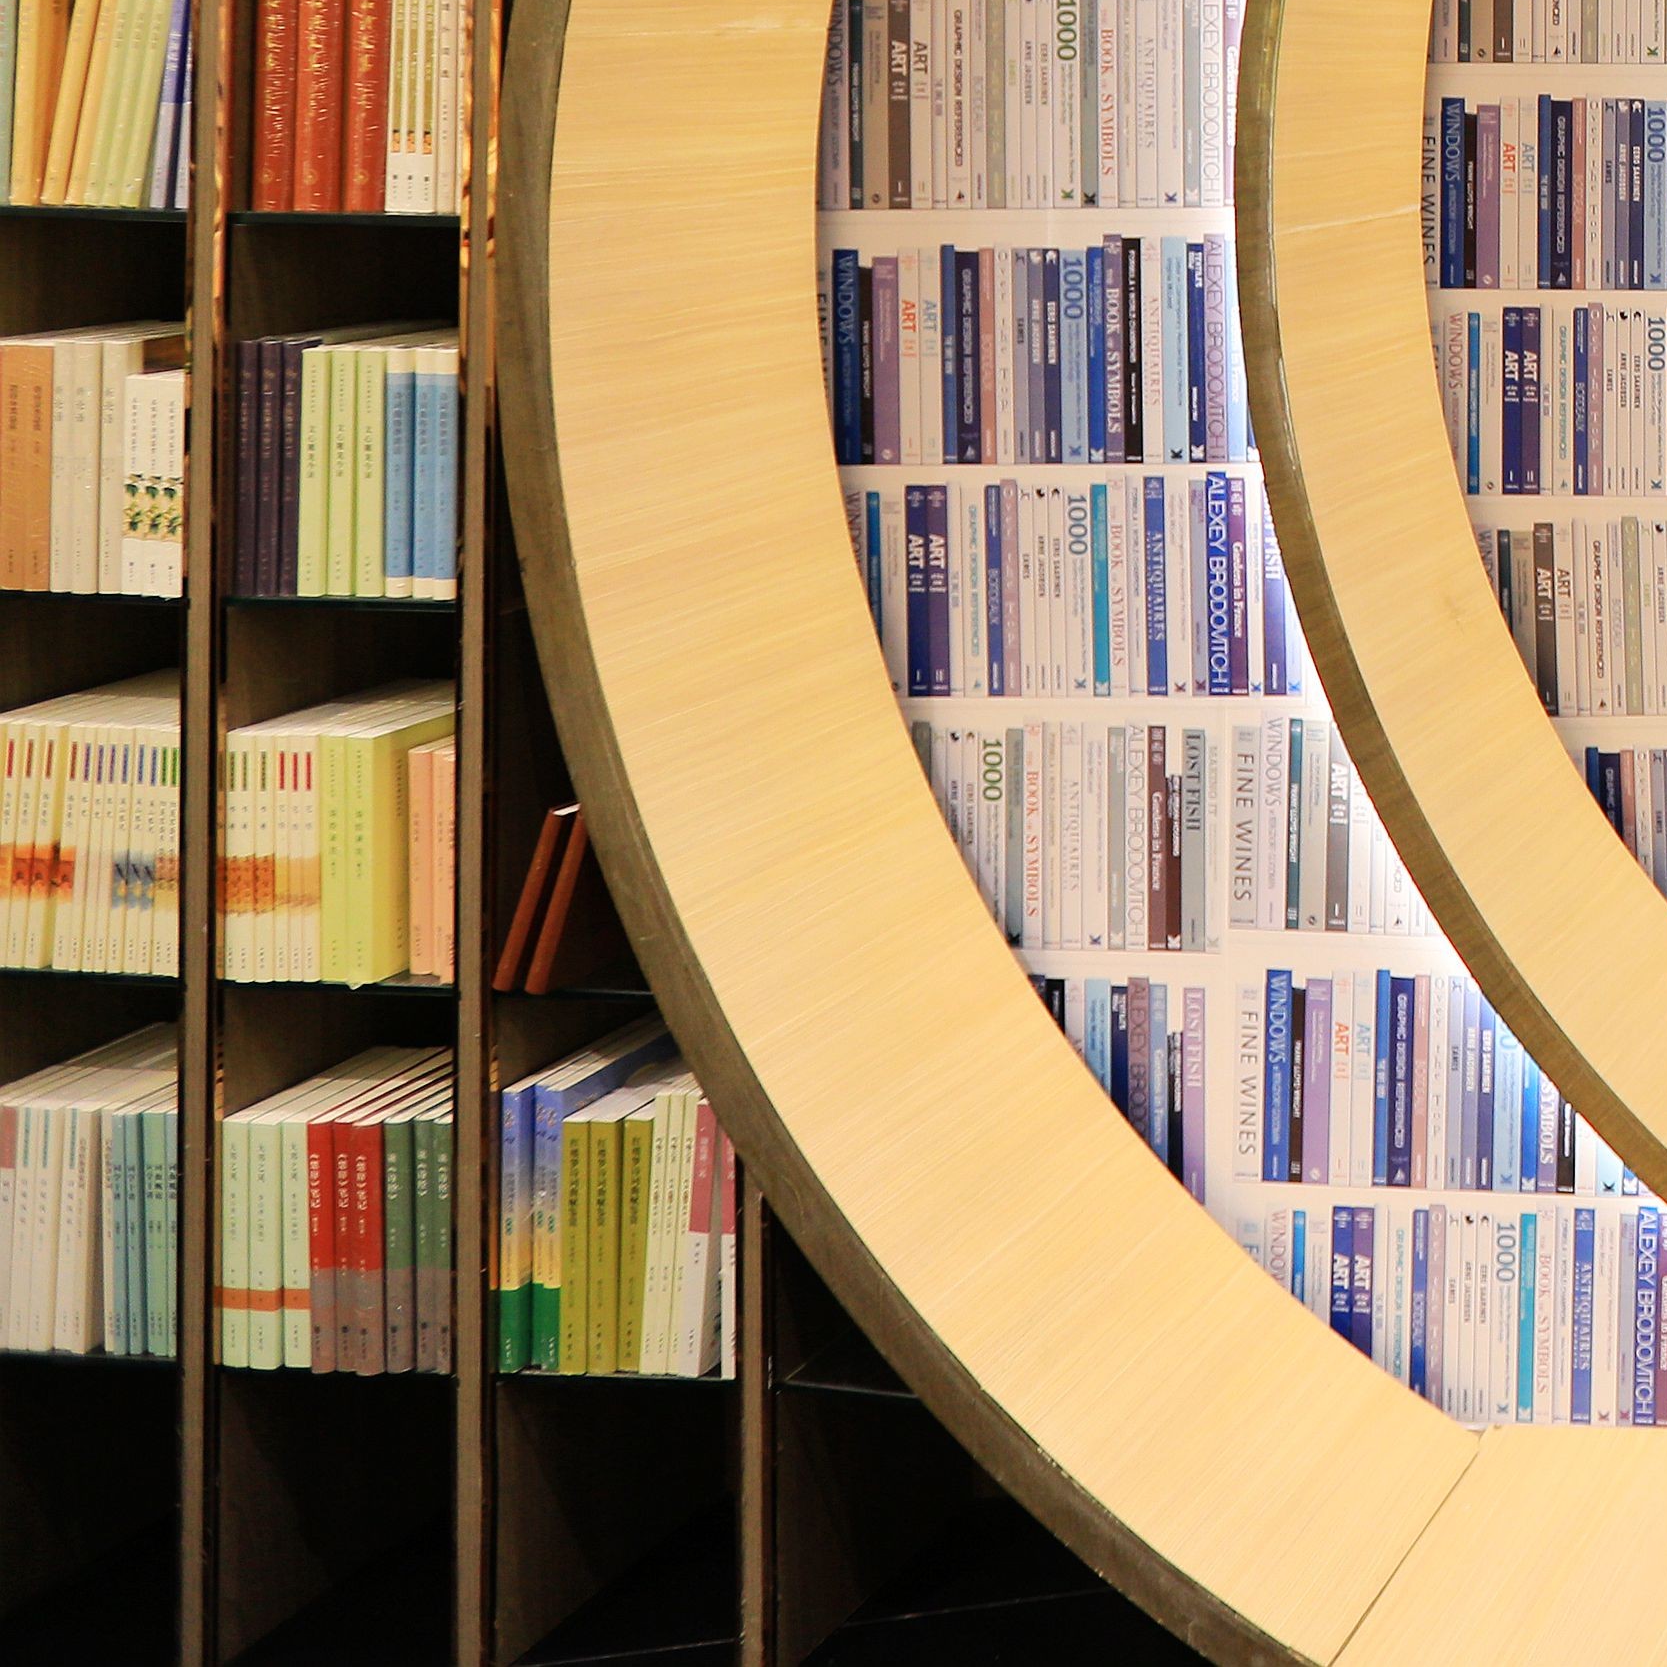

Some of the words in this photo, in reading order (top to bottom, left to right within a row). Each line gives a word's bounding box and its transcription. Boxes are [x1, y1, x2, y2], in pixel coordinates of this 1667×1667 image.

[892, 40, 907, 76] ART
[1101, 28, 1113, 70] BOOK
[1102, 93, 1113, 176] SYMBOLS
[1421, 137, 1435, 187] FINE
[1446, 103, 1460, 181] WINDOWS
[1648, 108, 1665, 162] 1000
[1420, 195, 1435, 265] WINES
[838, 254, 854, 344] WINDOWS
[1208, 238, 1223, 315] ALEXEY
[902, 299, 916, 333] ART
[1106, 288, 1119, 334] BOOK
[1107, 351, 1120, 433] SYMBOLS
[1068, 495, 1087, 555] 1000
[1209, 473, 1226, 552] ALEXEY
[909, 535, 924, 569] ART
[1232, 542, 1244, 586] Gardens
[1232, 601, 1244, 637] France
[983, 739, 1002, 801] 1000
[1129, 724, 1144, 801] ALEXEY
[1186, 733, 1200, 778] LOST
[1236, 752, 1254, 808] FINE
[1027, 771, 1038, 813] BOOK
[1187, 789, 1200, 832] FISH
[1026, 834, 1038, 920] SYMBOLS
[1234, 820, 1252, 900] WINES
[1241, 1010, 1258, 1064] FINE
[1269, 974, 1287, 1063] WINDOWS
[1334, 1022, 1349, 1055] ART
[1239, 1075, 1256, 1154] WINES
[1496, 1223, 1516, 1282] 1000
[1638, 1206, 1654, 1285] ALEXEY
